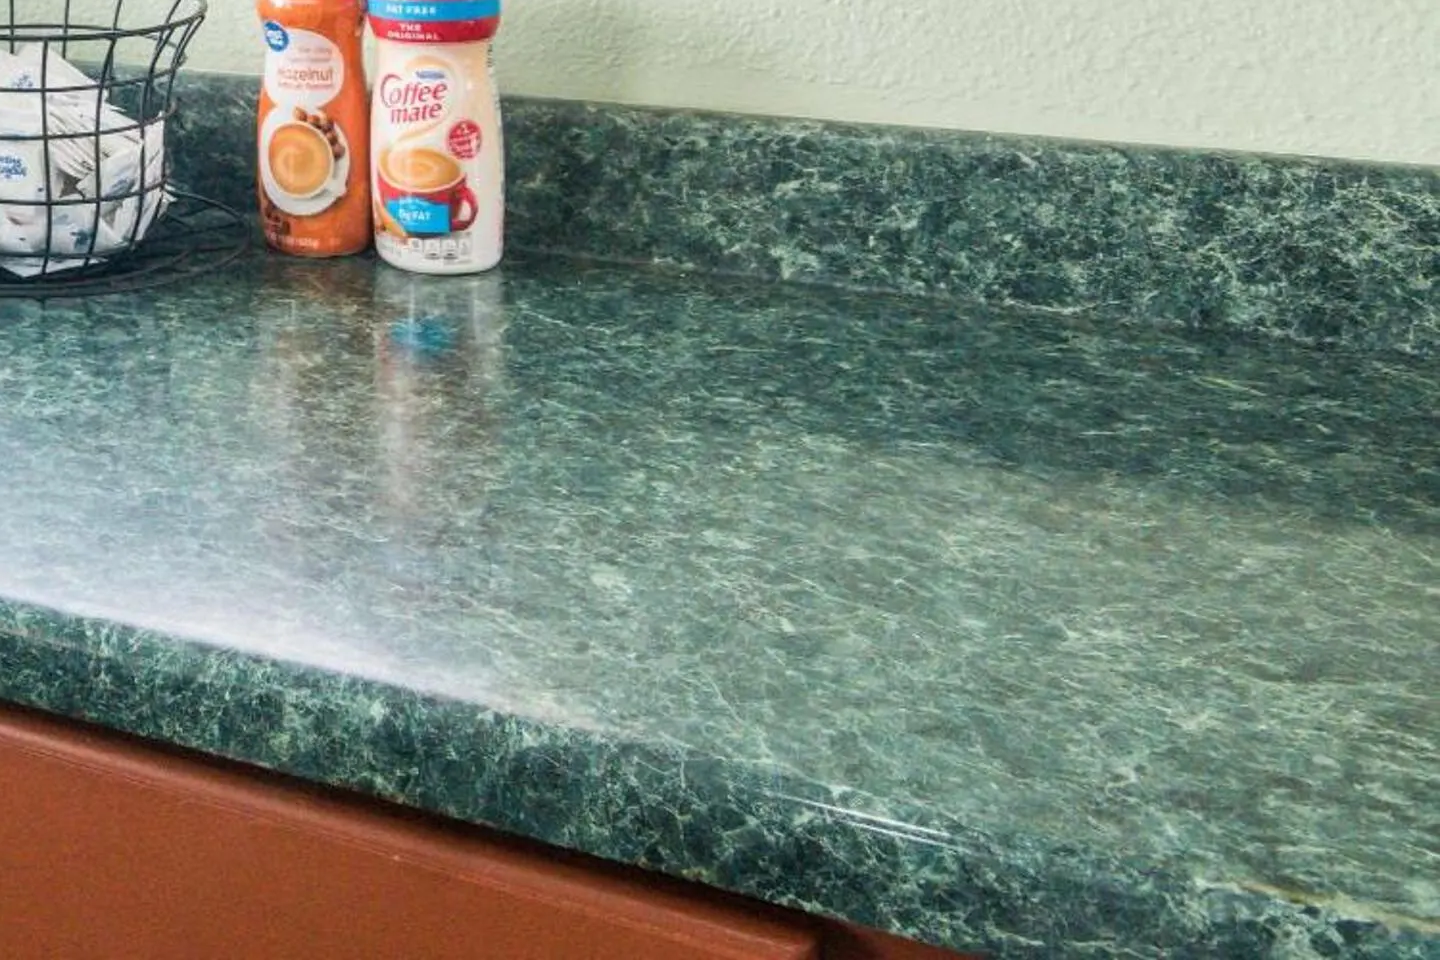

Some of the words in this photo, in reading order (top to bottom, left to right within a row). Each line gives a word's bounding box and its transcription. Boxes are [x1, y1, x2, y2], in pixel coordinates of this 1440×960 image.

[386, 3, 403, 14] FAT
[406, 5, 437, 16] FREE
[399, 23, 422, 32] THE
[387, 31, 440, 41] ORIGINAL
[380, 73, 448, 109] Coffee
[390, 102, 442, 125] mate
[411, 209, 431, 221] FAT
